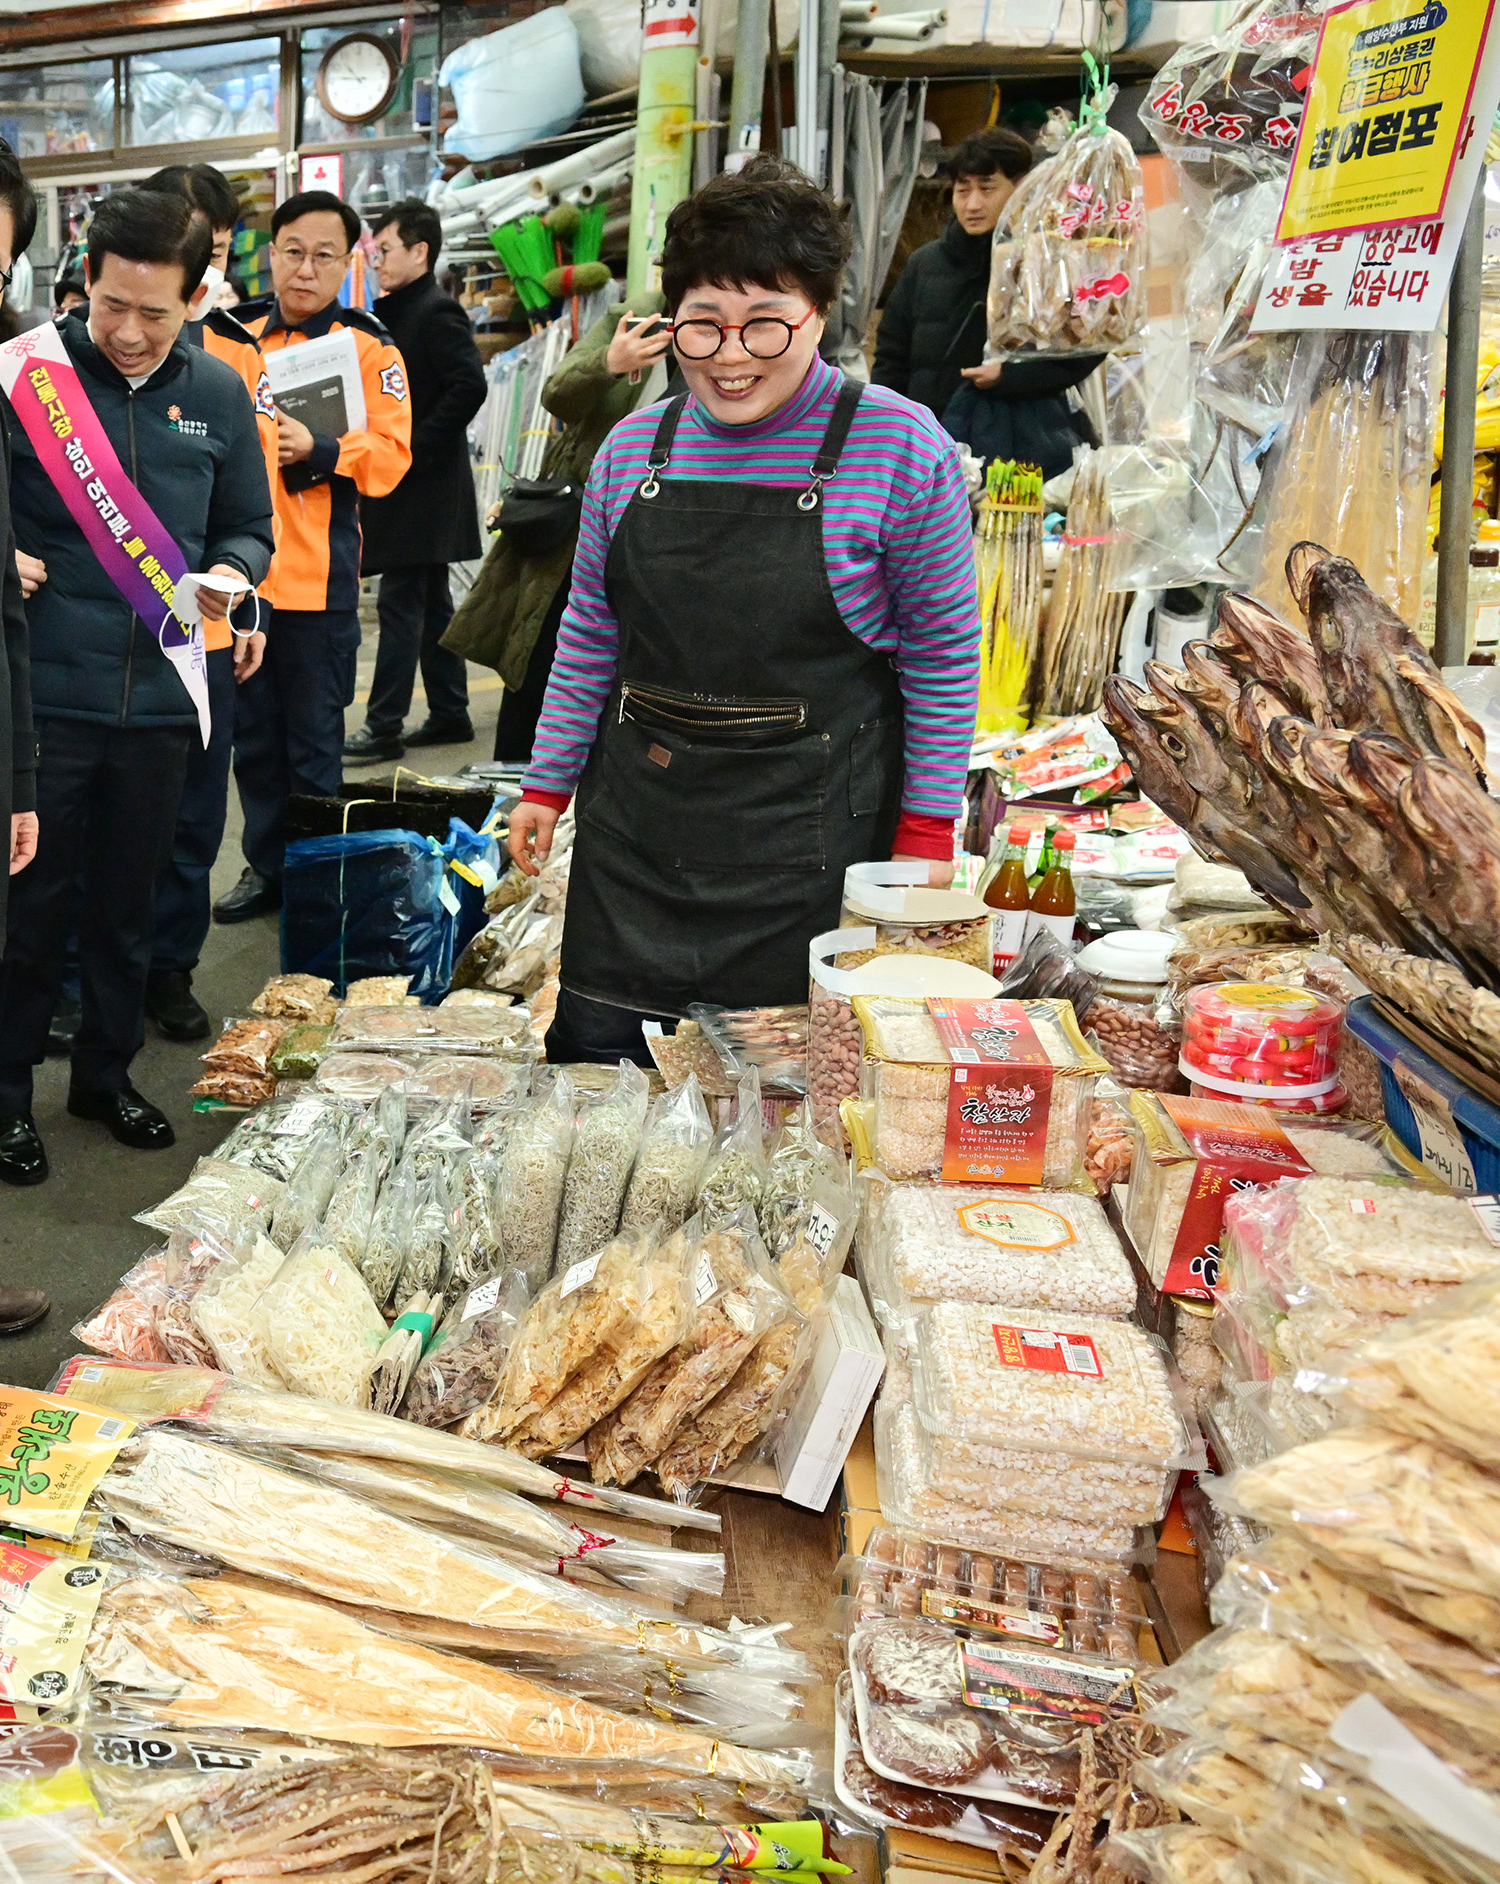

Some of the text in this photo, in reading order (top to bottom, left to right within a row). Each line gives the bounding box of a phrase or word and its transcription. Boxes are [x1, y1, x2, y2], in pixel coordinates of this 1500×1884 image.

[1365, 15, 1429, 44] 해양수산부 지원
[1348, 37, 1436, 77] 온누리상품권
[1338, 61, 1431, 114] 환급행사
[1308, 101, 1443, 170] 참여점포
[1289, 258, 1323, 280] 밤
[1266, 270, 1430, 308] 생율 있습니다
[27, 366, 75, 439] 전통시장
[65, 437, 96, 480] 상인
[122, 535, 148, 560] 늘
[960, 1098, 1031, 1124] 참산자
[998, 1328, 1021, 1363] 영양산자
